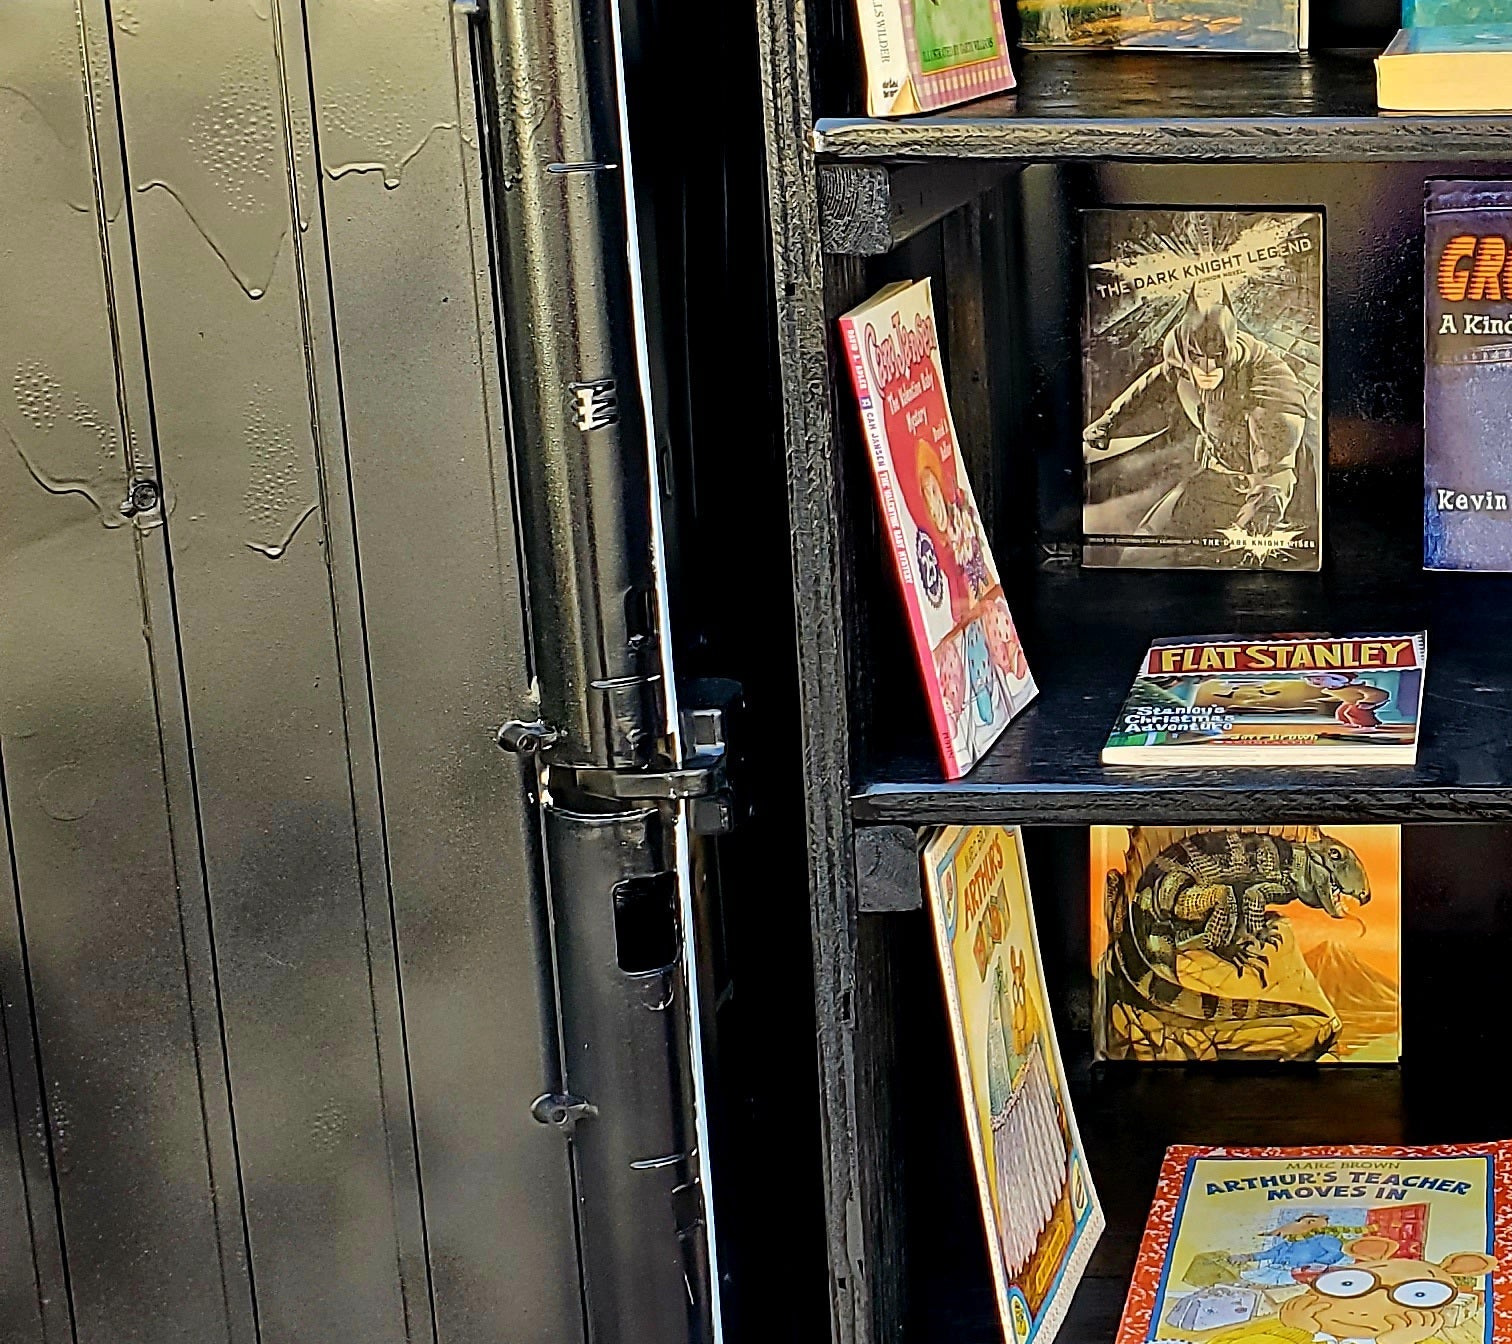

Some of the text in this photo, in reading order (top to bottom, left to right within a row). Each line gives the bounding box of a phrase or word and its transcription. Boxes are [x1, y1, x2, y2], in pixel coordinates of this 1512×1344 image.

[1097, 237, 1312, 300] THE DARK KNIGHT LEGEND
[1439, 314, 1456, 335] A
[865, 323, 895, 399] Cam
[1437, 489, 1508, 512] Kevin
[1161, 641, 1411, 673] FLAT STANLEY
[1125, 714, 1235, 725] Christmas
[1136, 704, 1226, 716] Stanley's
[1125, 722, 1233, 733] Adventure
[964, 833, 1004, 933] ARTHUR'S
[1285, 1161, 1400, 1170] MARC BROWN
[1206, 1172, 1472, 1196] ARTHUR'S TEACHER
[1267, 1185, 1408, 1201] MOVES IN
